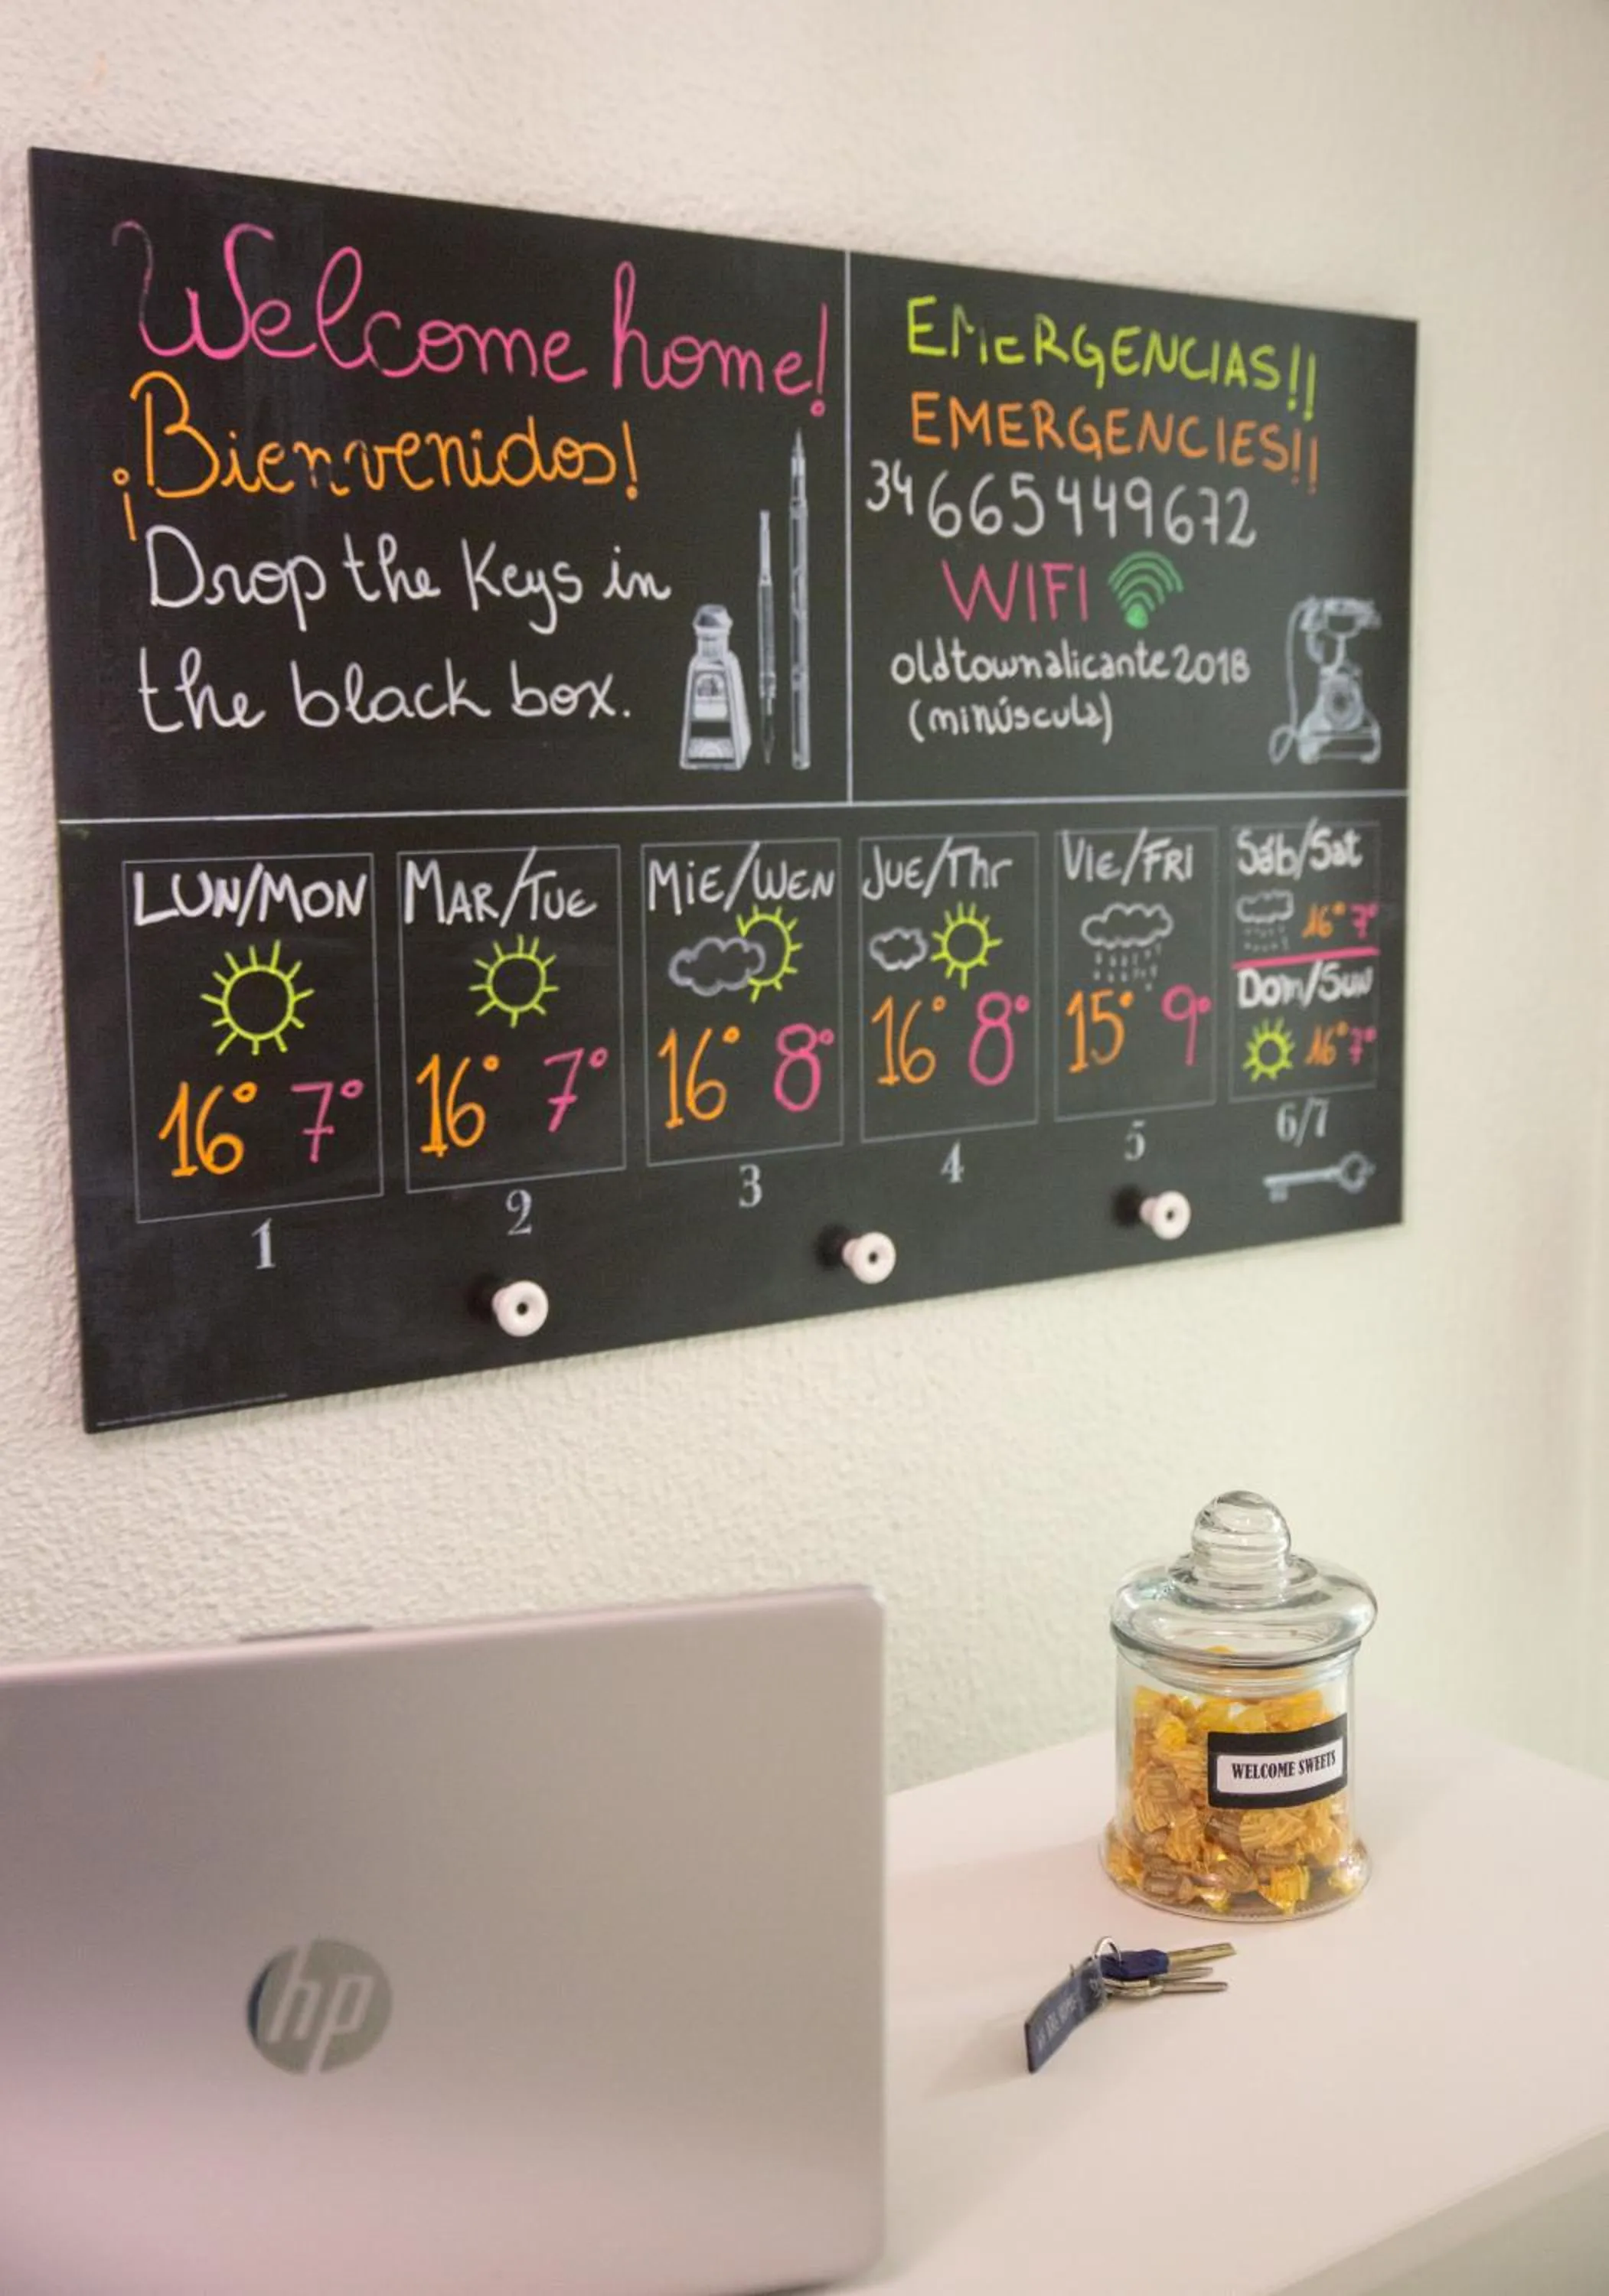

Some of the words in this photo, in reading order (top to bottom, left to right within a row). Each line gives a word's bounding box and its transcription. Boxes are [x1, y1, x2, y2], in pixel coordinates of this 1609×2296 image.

[112, 219, 588, 378] Welcome
[613, 260, 829, 417] home!
[911, 390, 1319, 495] EMERGENCIES!!
[865, 459, 914, 515] 34
[145, 525, 327, 631] Drop
[342, 533, 442, 603] the
[461, 538, 583, 634] Keys
[602, 545, 671, 601] in
[942, 558, 1088, 623] WIFI
[139, 647, 266, 733] the
[290, 658, 492, 728] black
[510, 660, 632, 719] box.
[132, 862, 369, 927] LUN/MON
[870, 994, 948, 1086] 16°
[968, 990, 1030, 1088] 8°
[1066, 989, 1135, 1075] 15°
[1161, 983, 1212, 1067] 9°
[415, 1053, 501, 1159] 16°
[543, 1047, 609, 1133] 7°
[658, 1026, 741, 1130] 16°
[773, 1022, 835, 1113] 8°
[159, 1081, 258, 1177] 16°
[291, 1078, 364, 1163] 7°
[1124, 1120, 1146, 1162] 5
[1276, 1096, 1330, 1146] 6/7
[737, 1163, 762, 1208] 3
[940, 1141, 964, 1185] 4
[251, 1218, 276, 1270] 1
[504, 1189, 534, 1237] 2
[1232, 1761, 1295, 1780] WELCOME
[1298, 1750, 1336, 1775] SWEETS
[265, 1942, 375, 2076] hp
